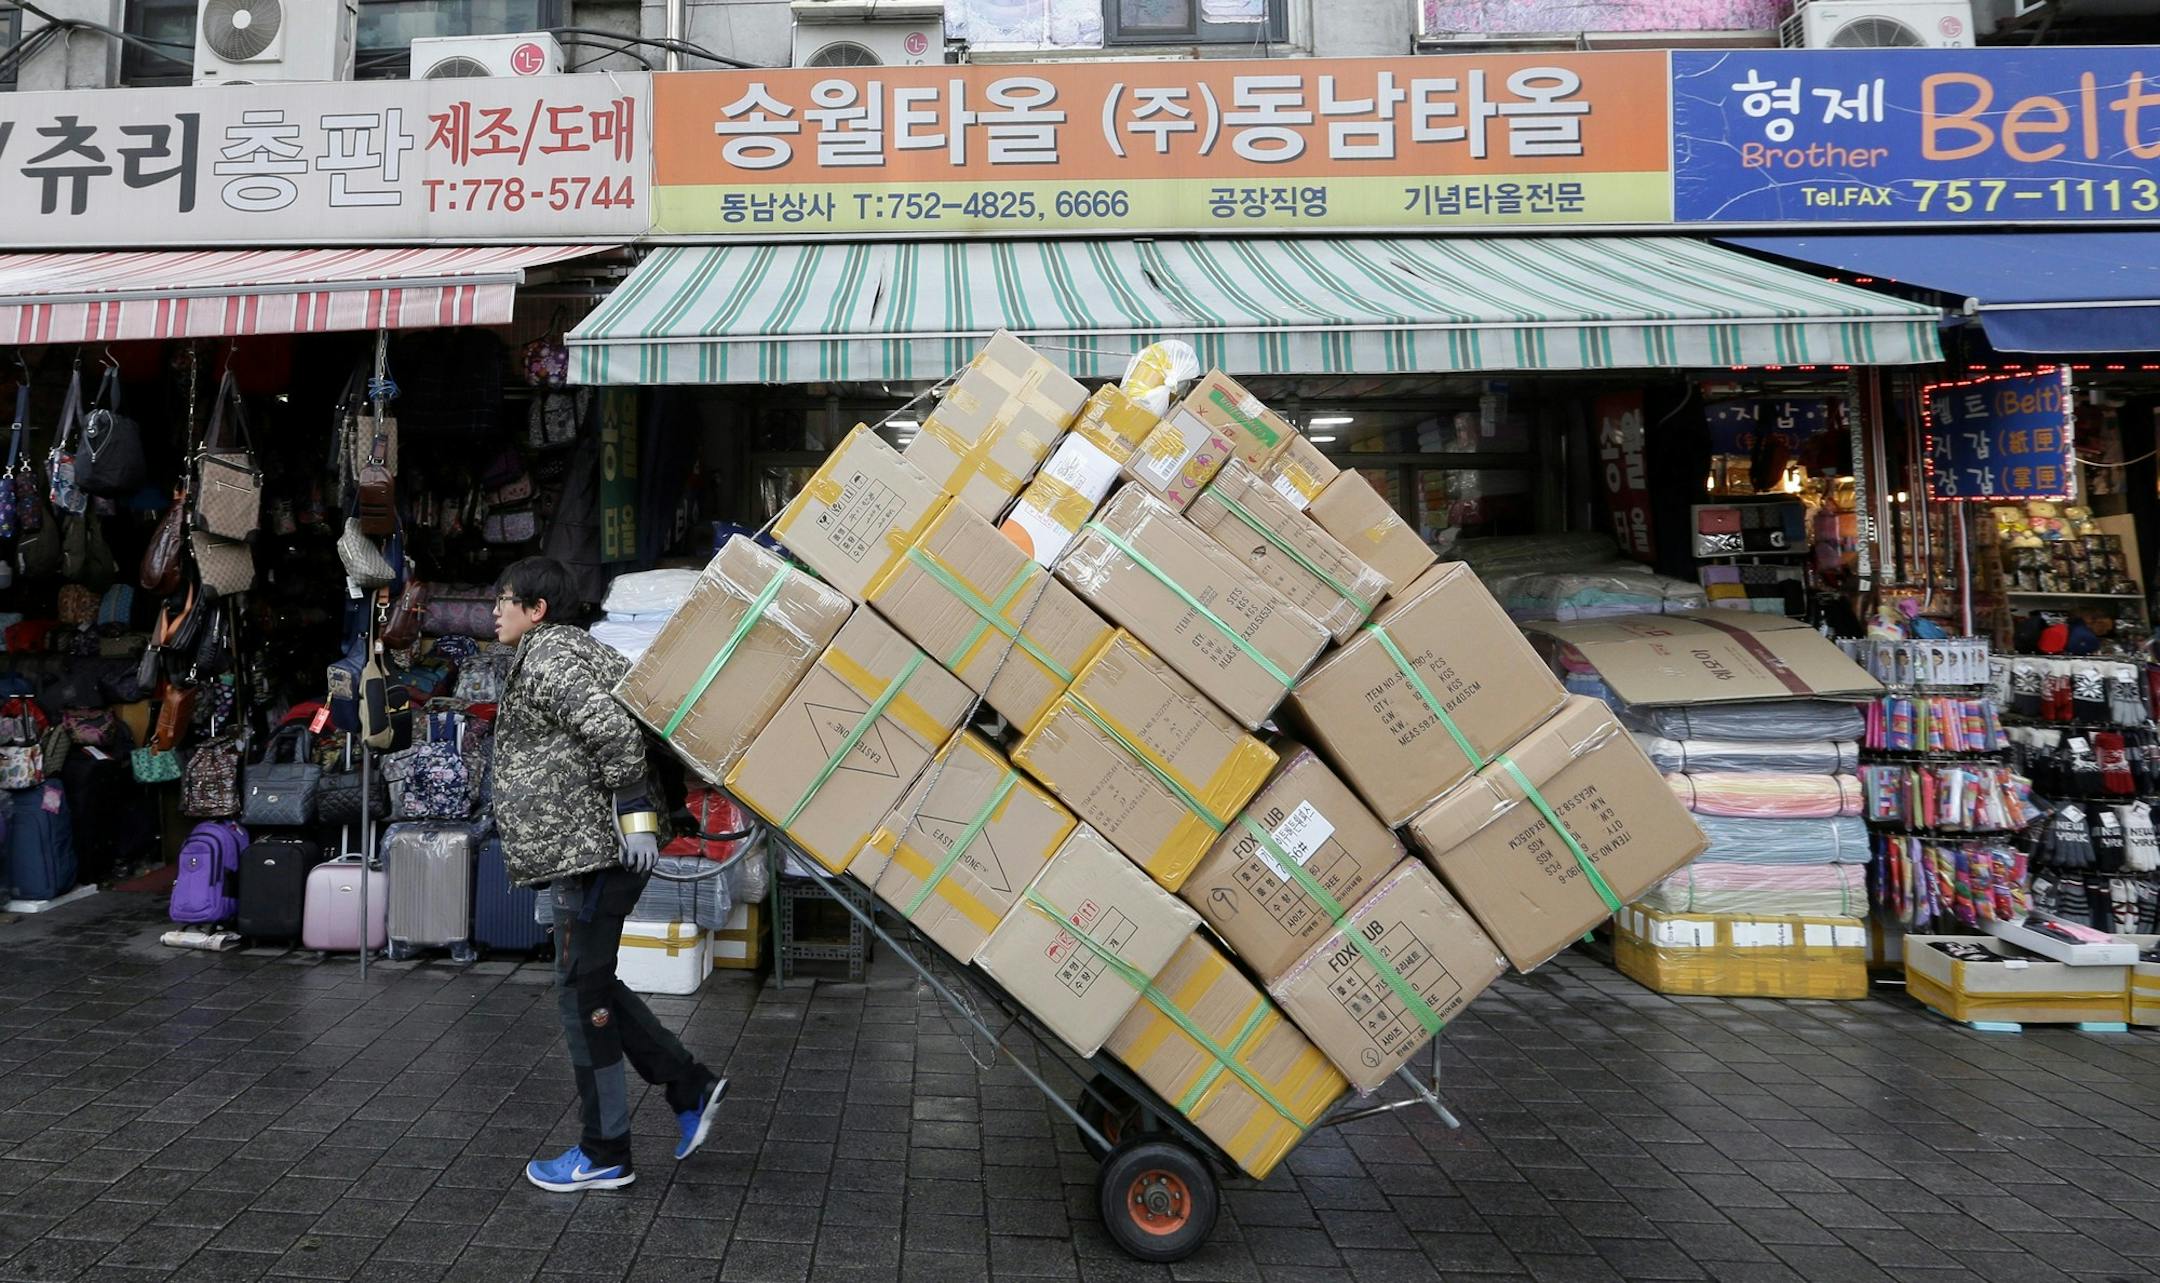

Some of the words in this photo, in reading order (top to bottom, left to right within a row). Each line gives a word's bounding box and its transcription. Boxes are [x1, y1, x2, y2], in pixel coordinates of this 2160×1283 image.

[714, 77, 1067, 169] 송월타올
[1921, 71, 2160, 163] Belt
[427, 97, 635, 167] 제조/도매
[214, 108, 414, 212] 총판
[1742, 142, 1888, 168] Brother
[422, 176, 635, 212] T:778-5744
[719, 192, 835, 223] 동남상사
[1055, 190, 1129, 218] 6666
[1209, 186, 1328, 217] 공장직영
[1404, 182, 1585, 216] 기념타올전문
[1801, 187, 1892, 207] Tel.FAX
[1438, 667, 1455, 682] KGS
[1446, 678, 1464, 693] KGS
[2055, 832, 2089, 842] YORK
[2056, 821, 2084, 831] NEW
[1526, 837, 1545, 853] KGS
[1534, 848, 1553, 865] KGS
